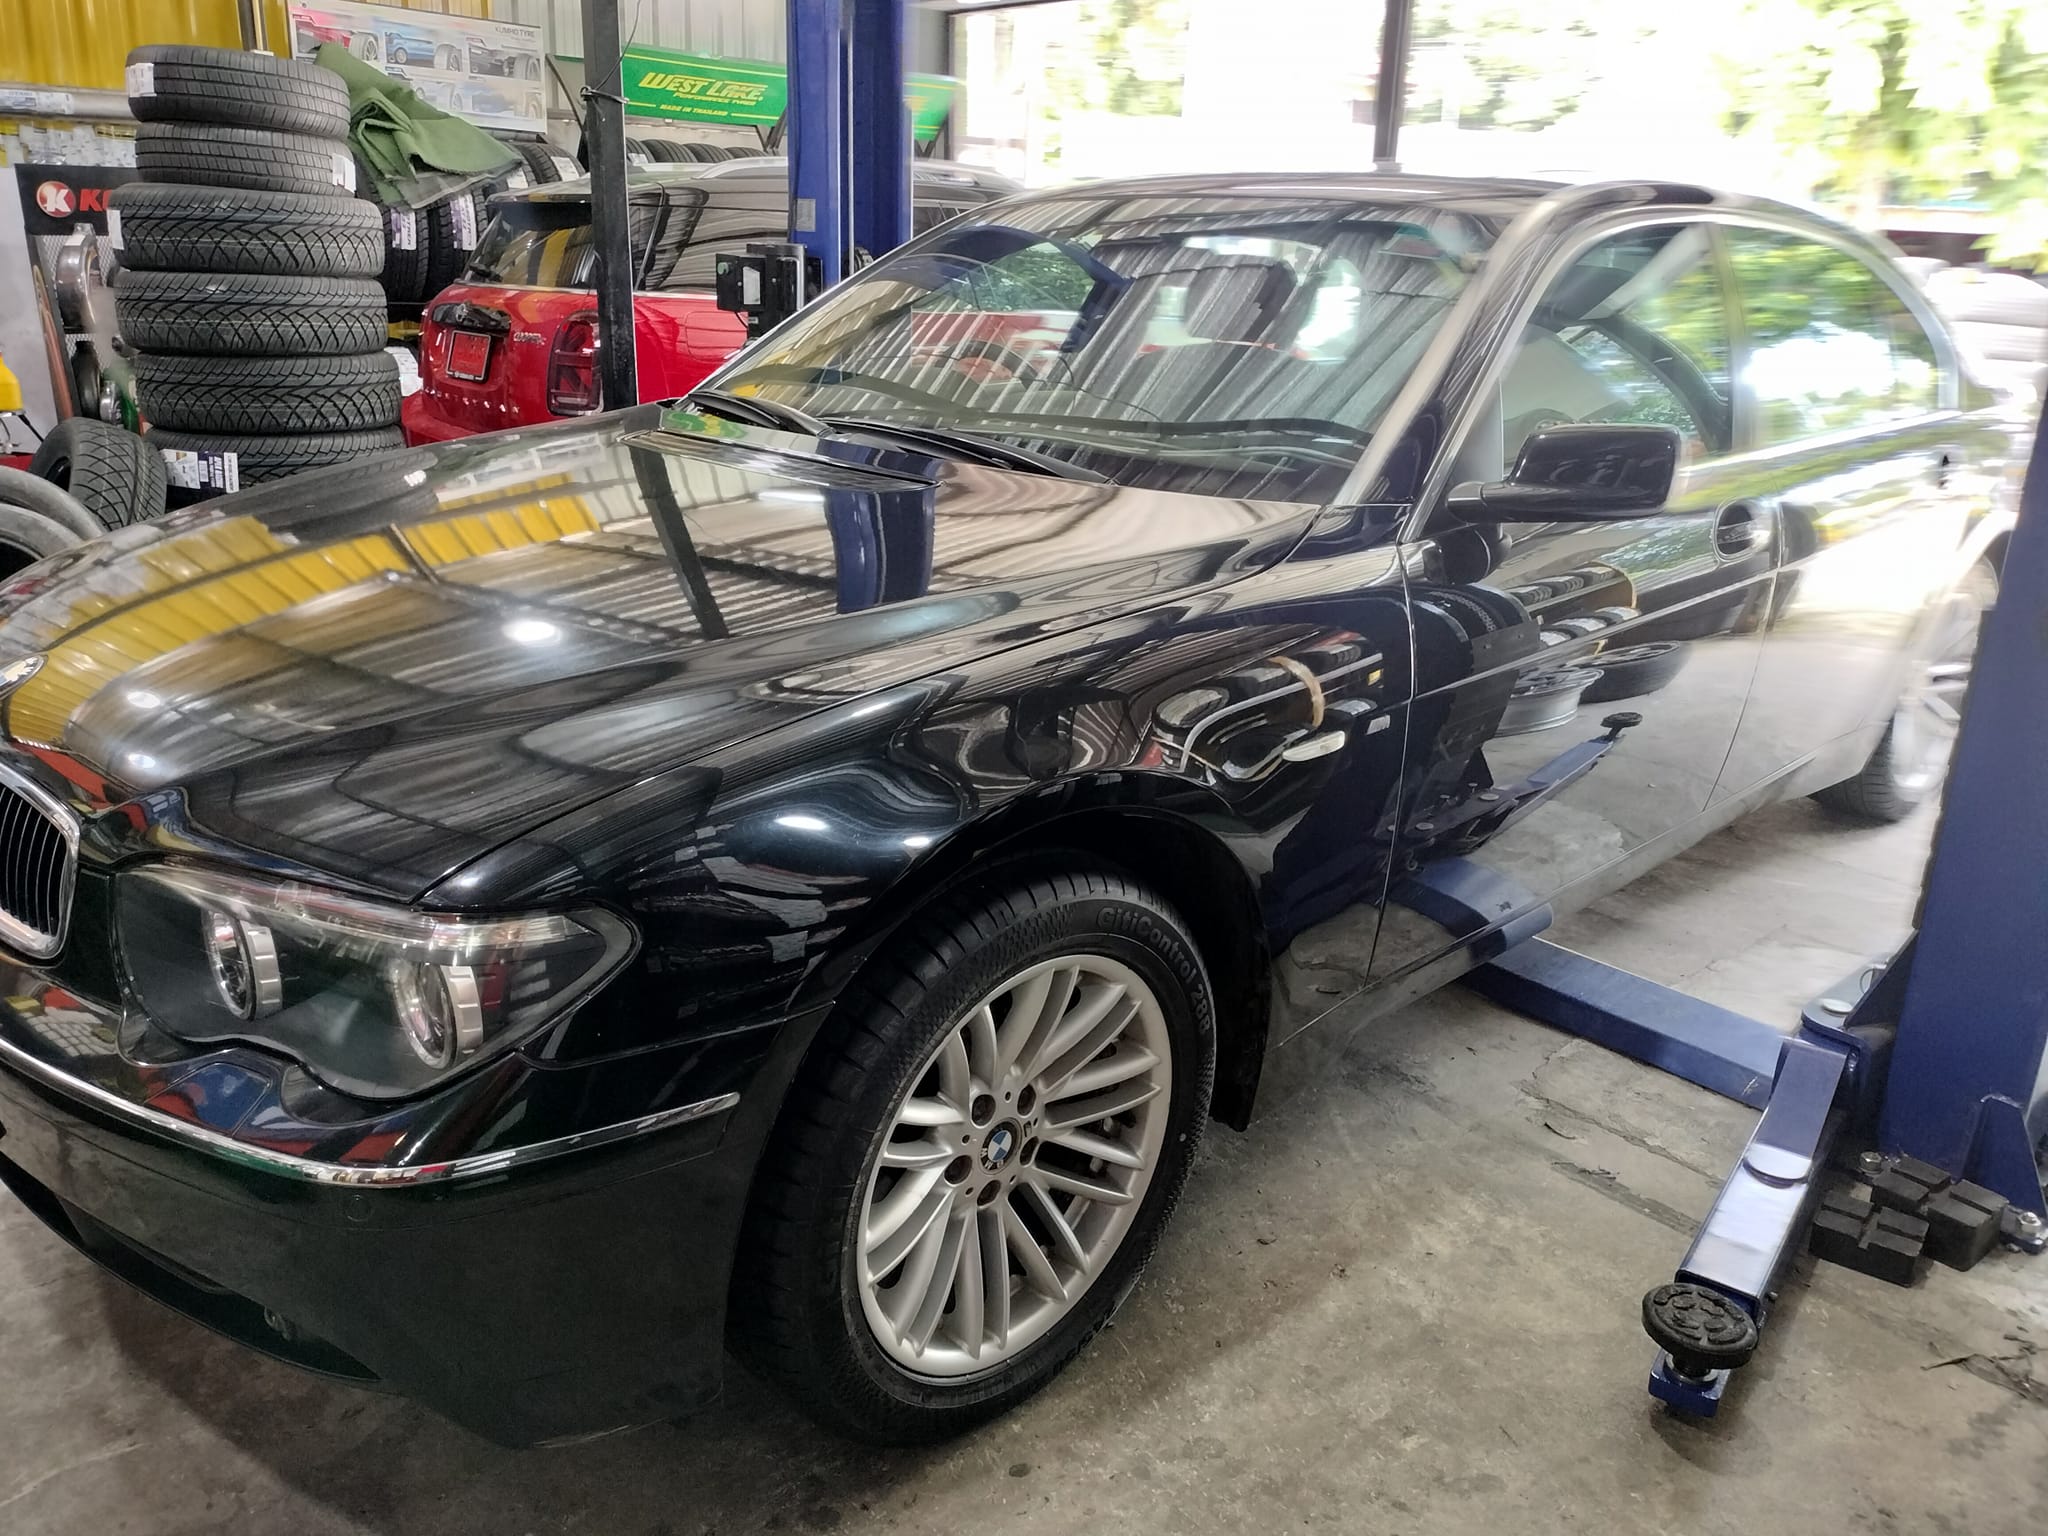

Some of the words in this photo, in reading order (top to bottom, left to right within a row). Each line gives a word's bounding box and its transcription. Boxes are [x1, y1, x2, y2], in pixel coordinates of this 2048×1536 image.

[638, 72, 715, 94] WEST
[706, 81, 768, 100] LAKE
[1097, 907, 1197, 984] GitiControl
